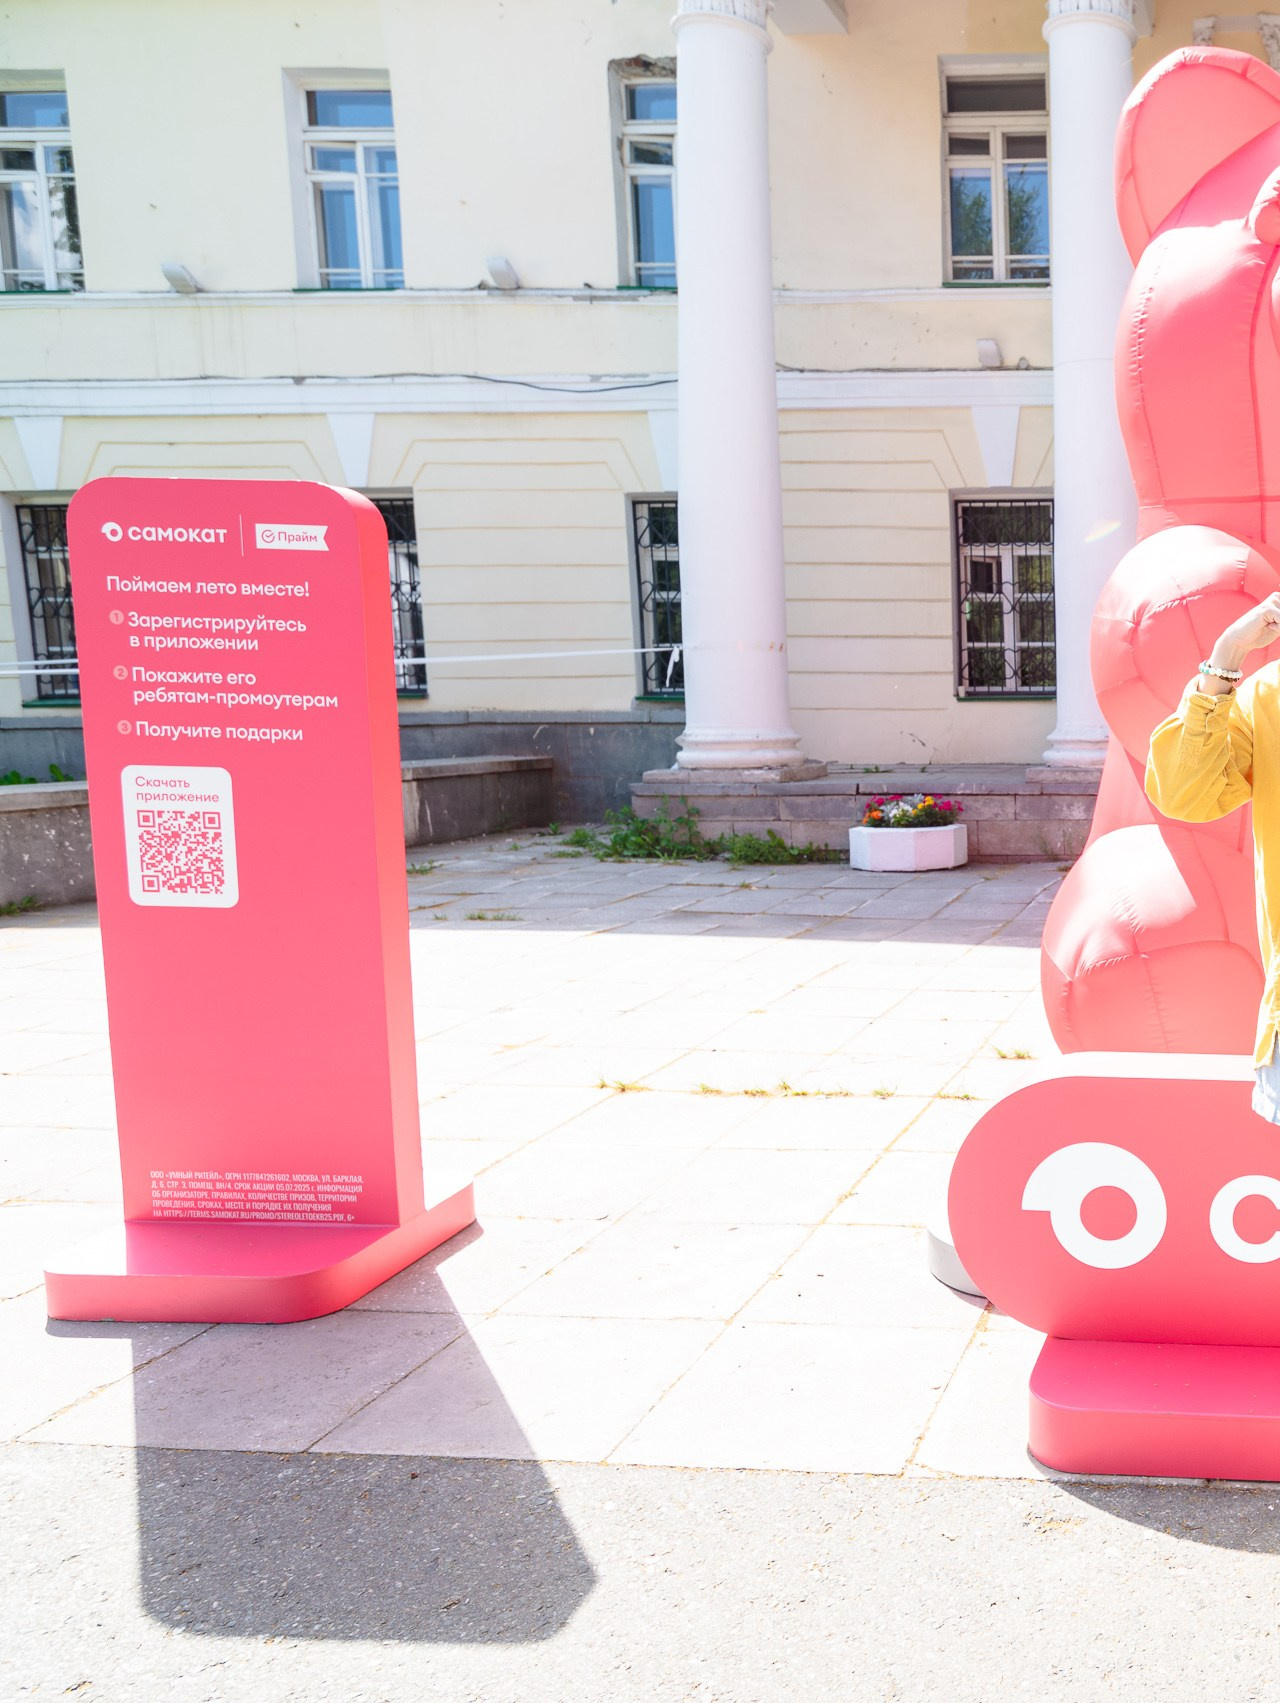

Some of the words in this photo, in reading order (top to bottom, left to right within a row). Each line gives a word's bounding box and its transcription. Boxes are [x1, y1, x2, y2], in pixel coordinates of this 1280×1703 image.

[128, 526, 227, 543] самокат
[278, 531, 318, 544] Прайм
[106, 576, 192, 594] Поймаем
[196, 581, 236, 595] лето
[242, 582, 310, 596] вместе!
[128, 612, 306, 634] Зарегистрируйтесь
[130, 636, 140, 648] в
[144, 636, 258, 651] приложении
[132, 667, 222, 684] Покажите
[226, 672, 256, 686] его
[134, 688, 338, 708] ребятам-промоутерам
[136, 721, 222, 740] Получите
[226, 726, 303, 742] подарки
[135, 776, 190, 788] Скачать
[136, 792, 220, 803] приложение
[317, 1185, 362, 1193] ИНФОРМАЦИЯ
[318, 1194, 357, 1202] ТЕРРИТОРИИ
[252, 1202, 282, 1210] ПОРЯДКЕ
[294, 1203, 332, 1212] ПОЛУЧЕНИЯ
